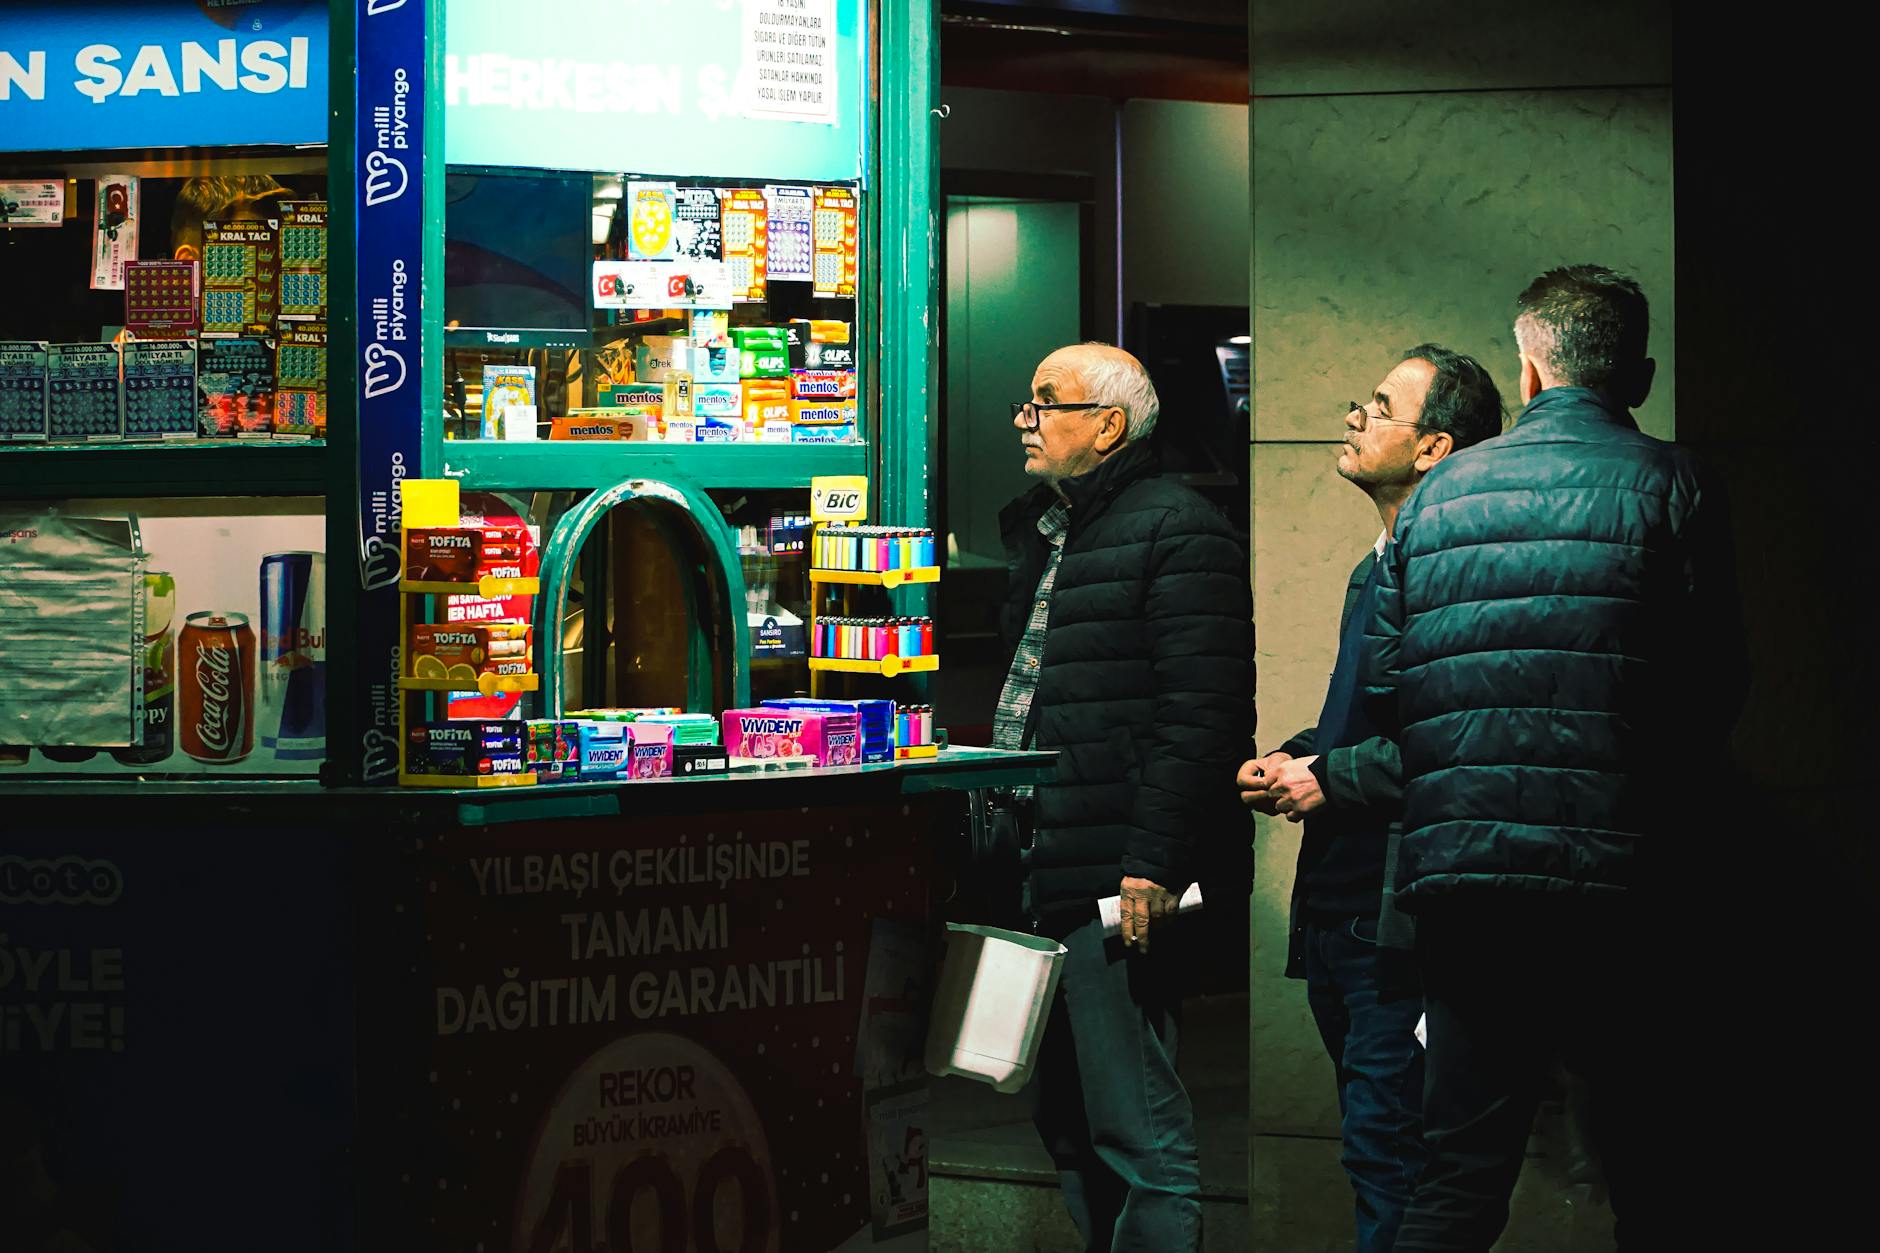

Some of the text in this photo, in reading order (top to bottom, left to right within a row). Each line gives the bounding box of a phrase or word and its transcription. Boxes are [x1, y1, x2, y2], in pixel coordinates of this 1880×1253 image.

[74, 37, 309, 103] ŞANSI
[791, 71, 823, 85] HAKKINDA
[758, 87, 776, 101] YASAL
[391, 68, 410, 149] piyango
[374, 106, 389, 149] milli
[297, 214, 323, 222] KRAL
[220, 232, 270, 241] KRAL TACI
[389, 259, 407, 341] piyango
[373, 298, 388, 340] milli
[295, 333, 320, 342] KRAL
[616, 392, 664, 404] mentos
[800, 382, 839, 393] mentos
[698, 395, 727, 404] mentos
[801, 407, 839, 420] mentos
[569, 425, 614, 435] mentos
[699, 427, 728, 437] mentos
[372, 491, 387, 534] milli
[466, 603, 505, 620] HAFTA
[296, 627, 325, 650] Bul
[371, 684, 386, 726] milli
[470, 832, 811, 898] YILBAŞI ÇEKİLİŞİNDE
[561, 903, 728, 960] TAMAMI
[435, 940, 845, 1035] DAĞITIM GARANTİLİ
[599, 1066, 696, 1107] REKOR
[573, 1105, 721, 1147] BÜYÜK İKRAMİYE
